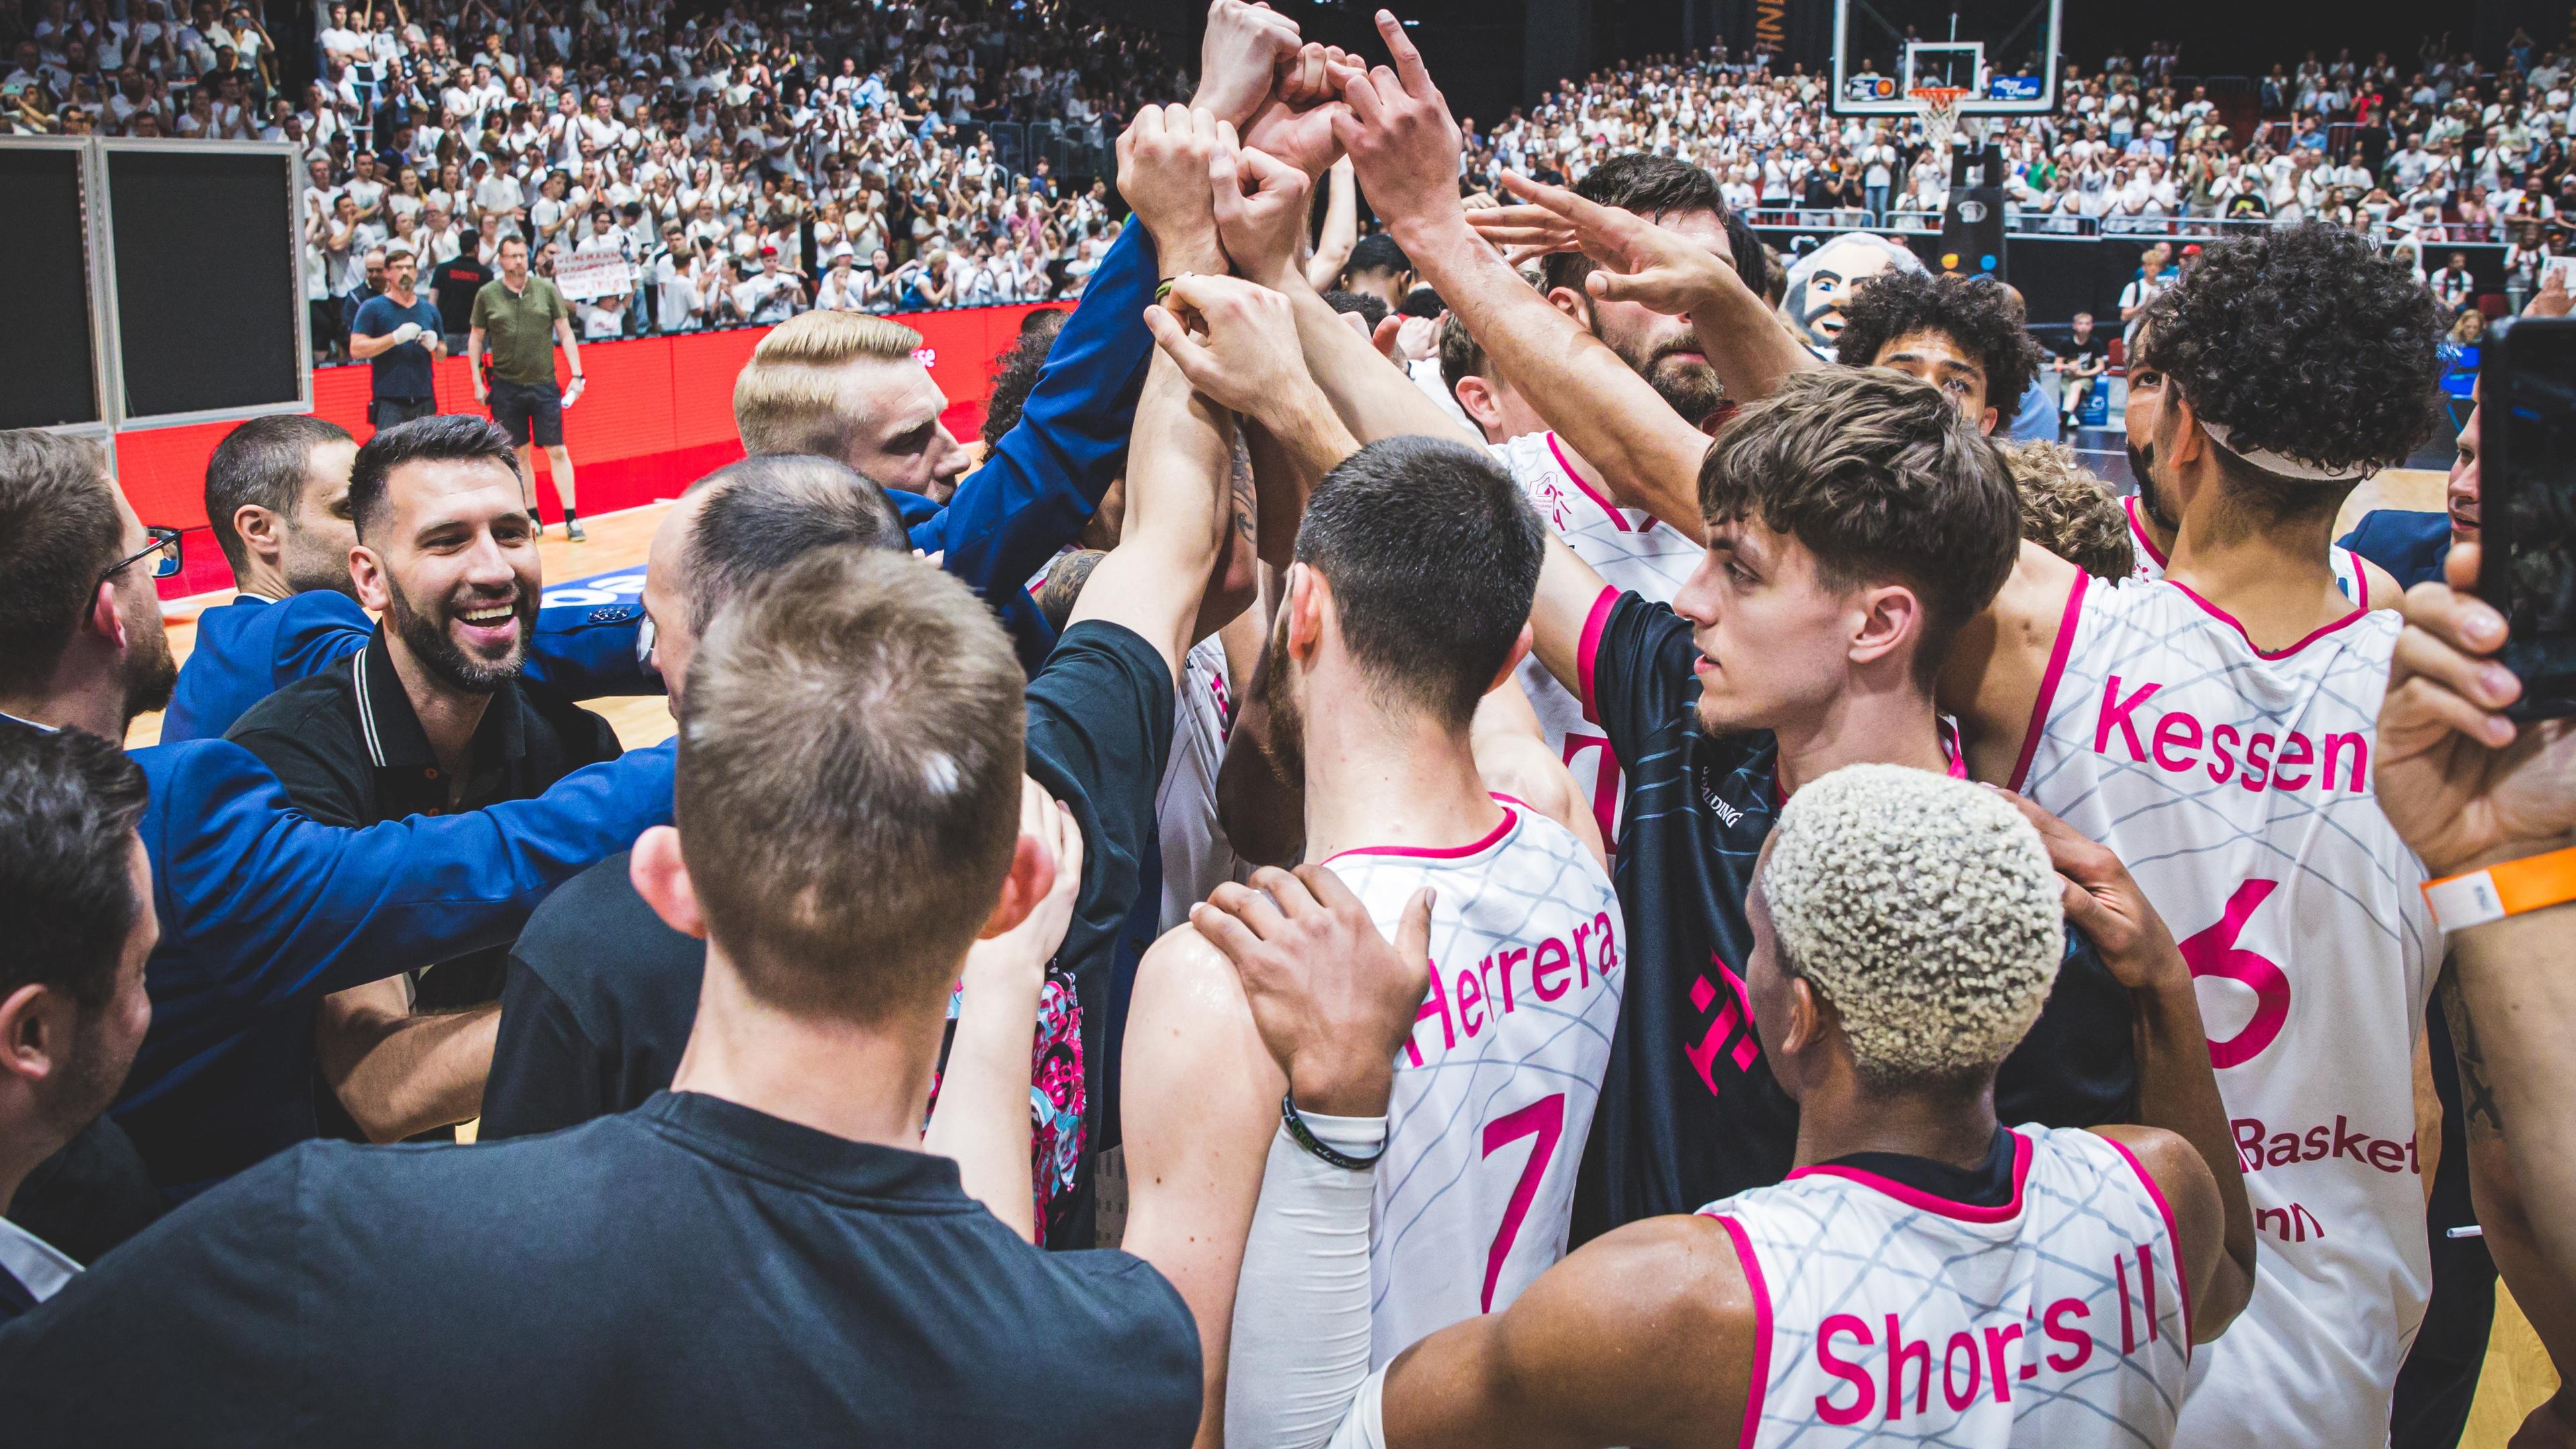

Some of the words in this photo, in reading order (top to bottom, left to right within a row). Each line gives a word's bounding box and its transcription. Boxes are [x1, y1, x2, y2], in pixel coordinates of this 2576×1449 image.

[2094, 675, 2368, 793] Kessen
[1403, 912, 1618, 1069] Herrera
[2178, 878, 2291, 1069] 6
[1480, 1093, 1565, 1314] 7
[2231, 1114, 2420, 1175] Basket
[2255, 1202, 2325, 1242] nn
